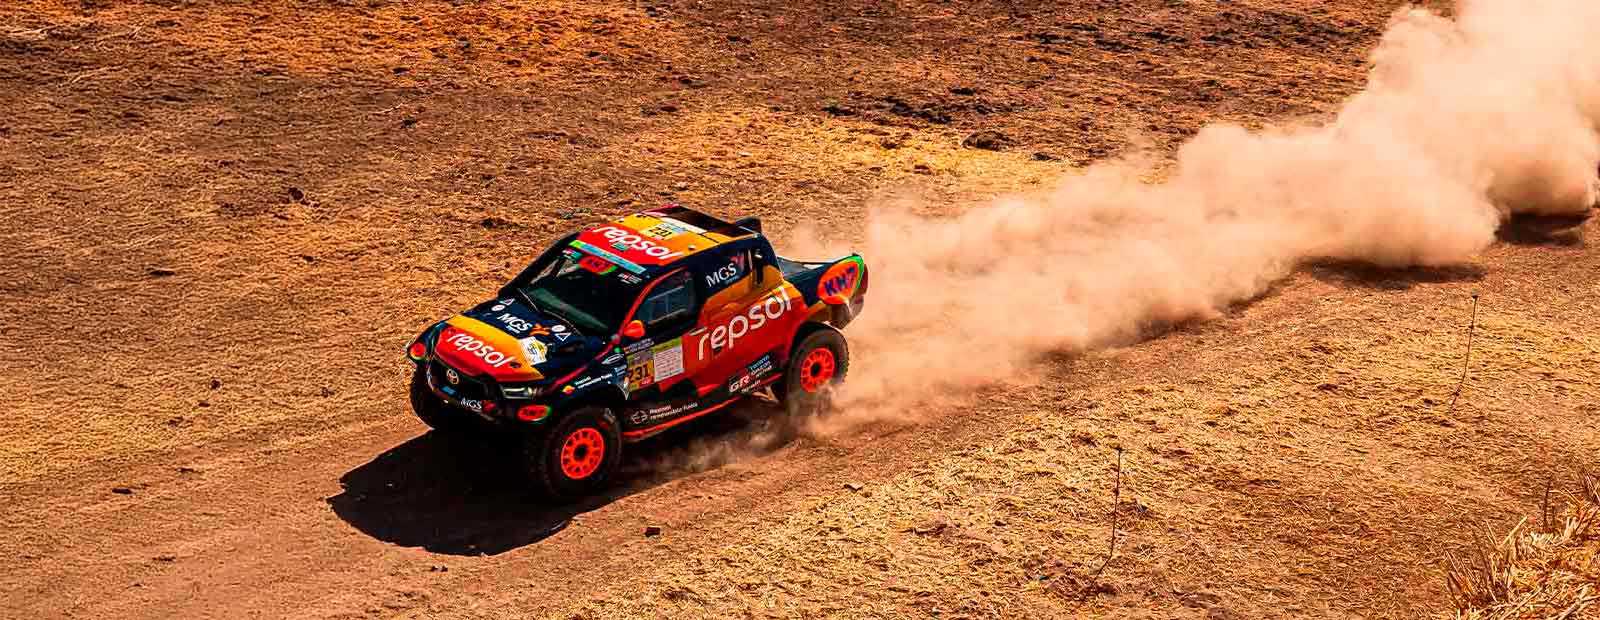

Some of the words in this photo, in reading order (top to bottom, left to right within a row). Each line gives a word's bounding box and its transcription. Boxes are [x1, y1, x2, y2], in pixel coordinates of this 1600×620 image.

[593, 226, 683, 260] repsol
[705, 262, 737, 288] MGS
[824, 265, 856, 297] KH7
[497, 313, 534, 332] MGS
[698, 285, 792, 361] repsol
[447, 333, 517, 368] repsol
[627, 363, 650, 384] 231
[729, 375, 750, 393] GR
[460, 398, 483, 410] MGS
